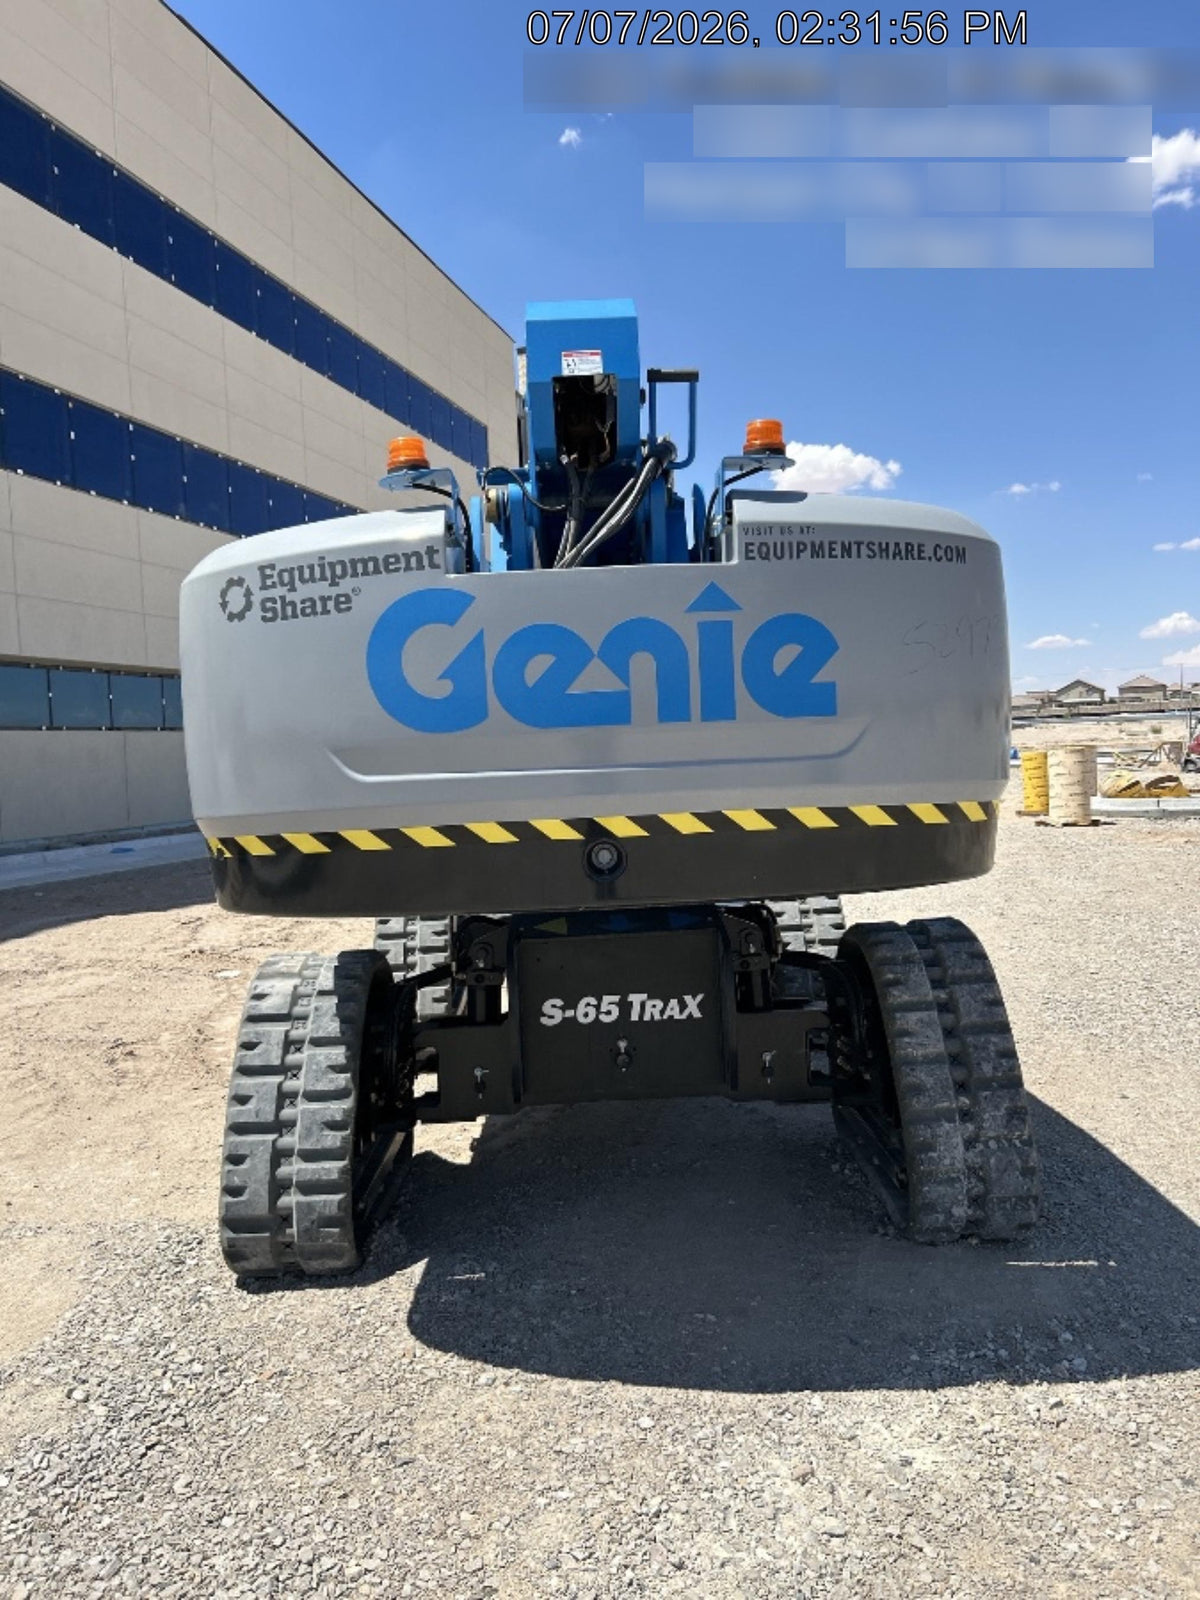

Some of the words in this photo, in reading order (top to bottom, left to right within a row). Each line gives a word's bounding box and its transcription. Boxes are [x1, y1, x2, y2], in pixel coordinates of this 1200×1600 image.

[742, 526, 773, 536] VISIT
[744, 539, 967, 565] EQUIPMENTSHARE.COM
[257, 545, 441, 593] Equipment
[367, 582, 839, 733] Genie
[540, 994, 621, 1027] S-65
